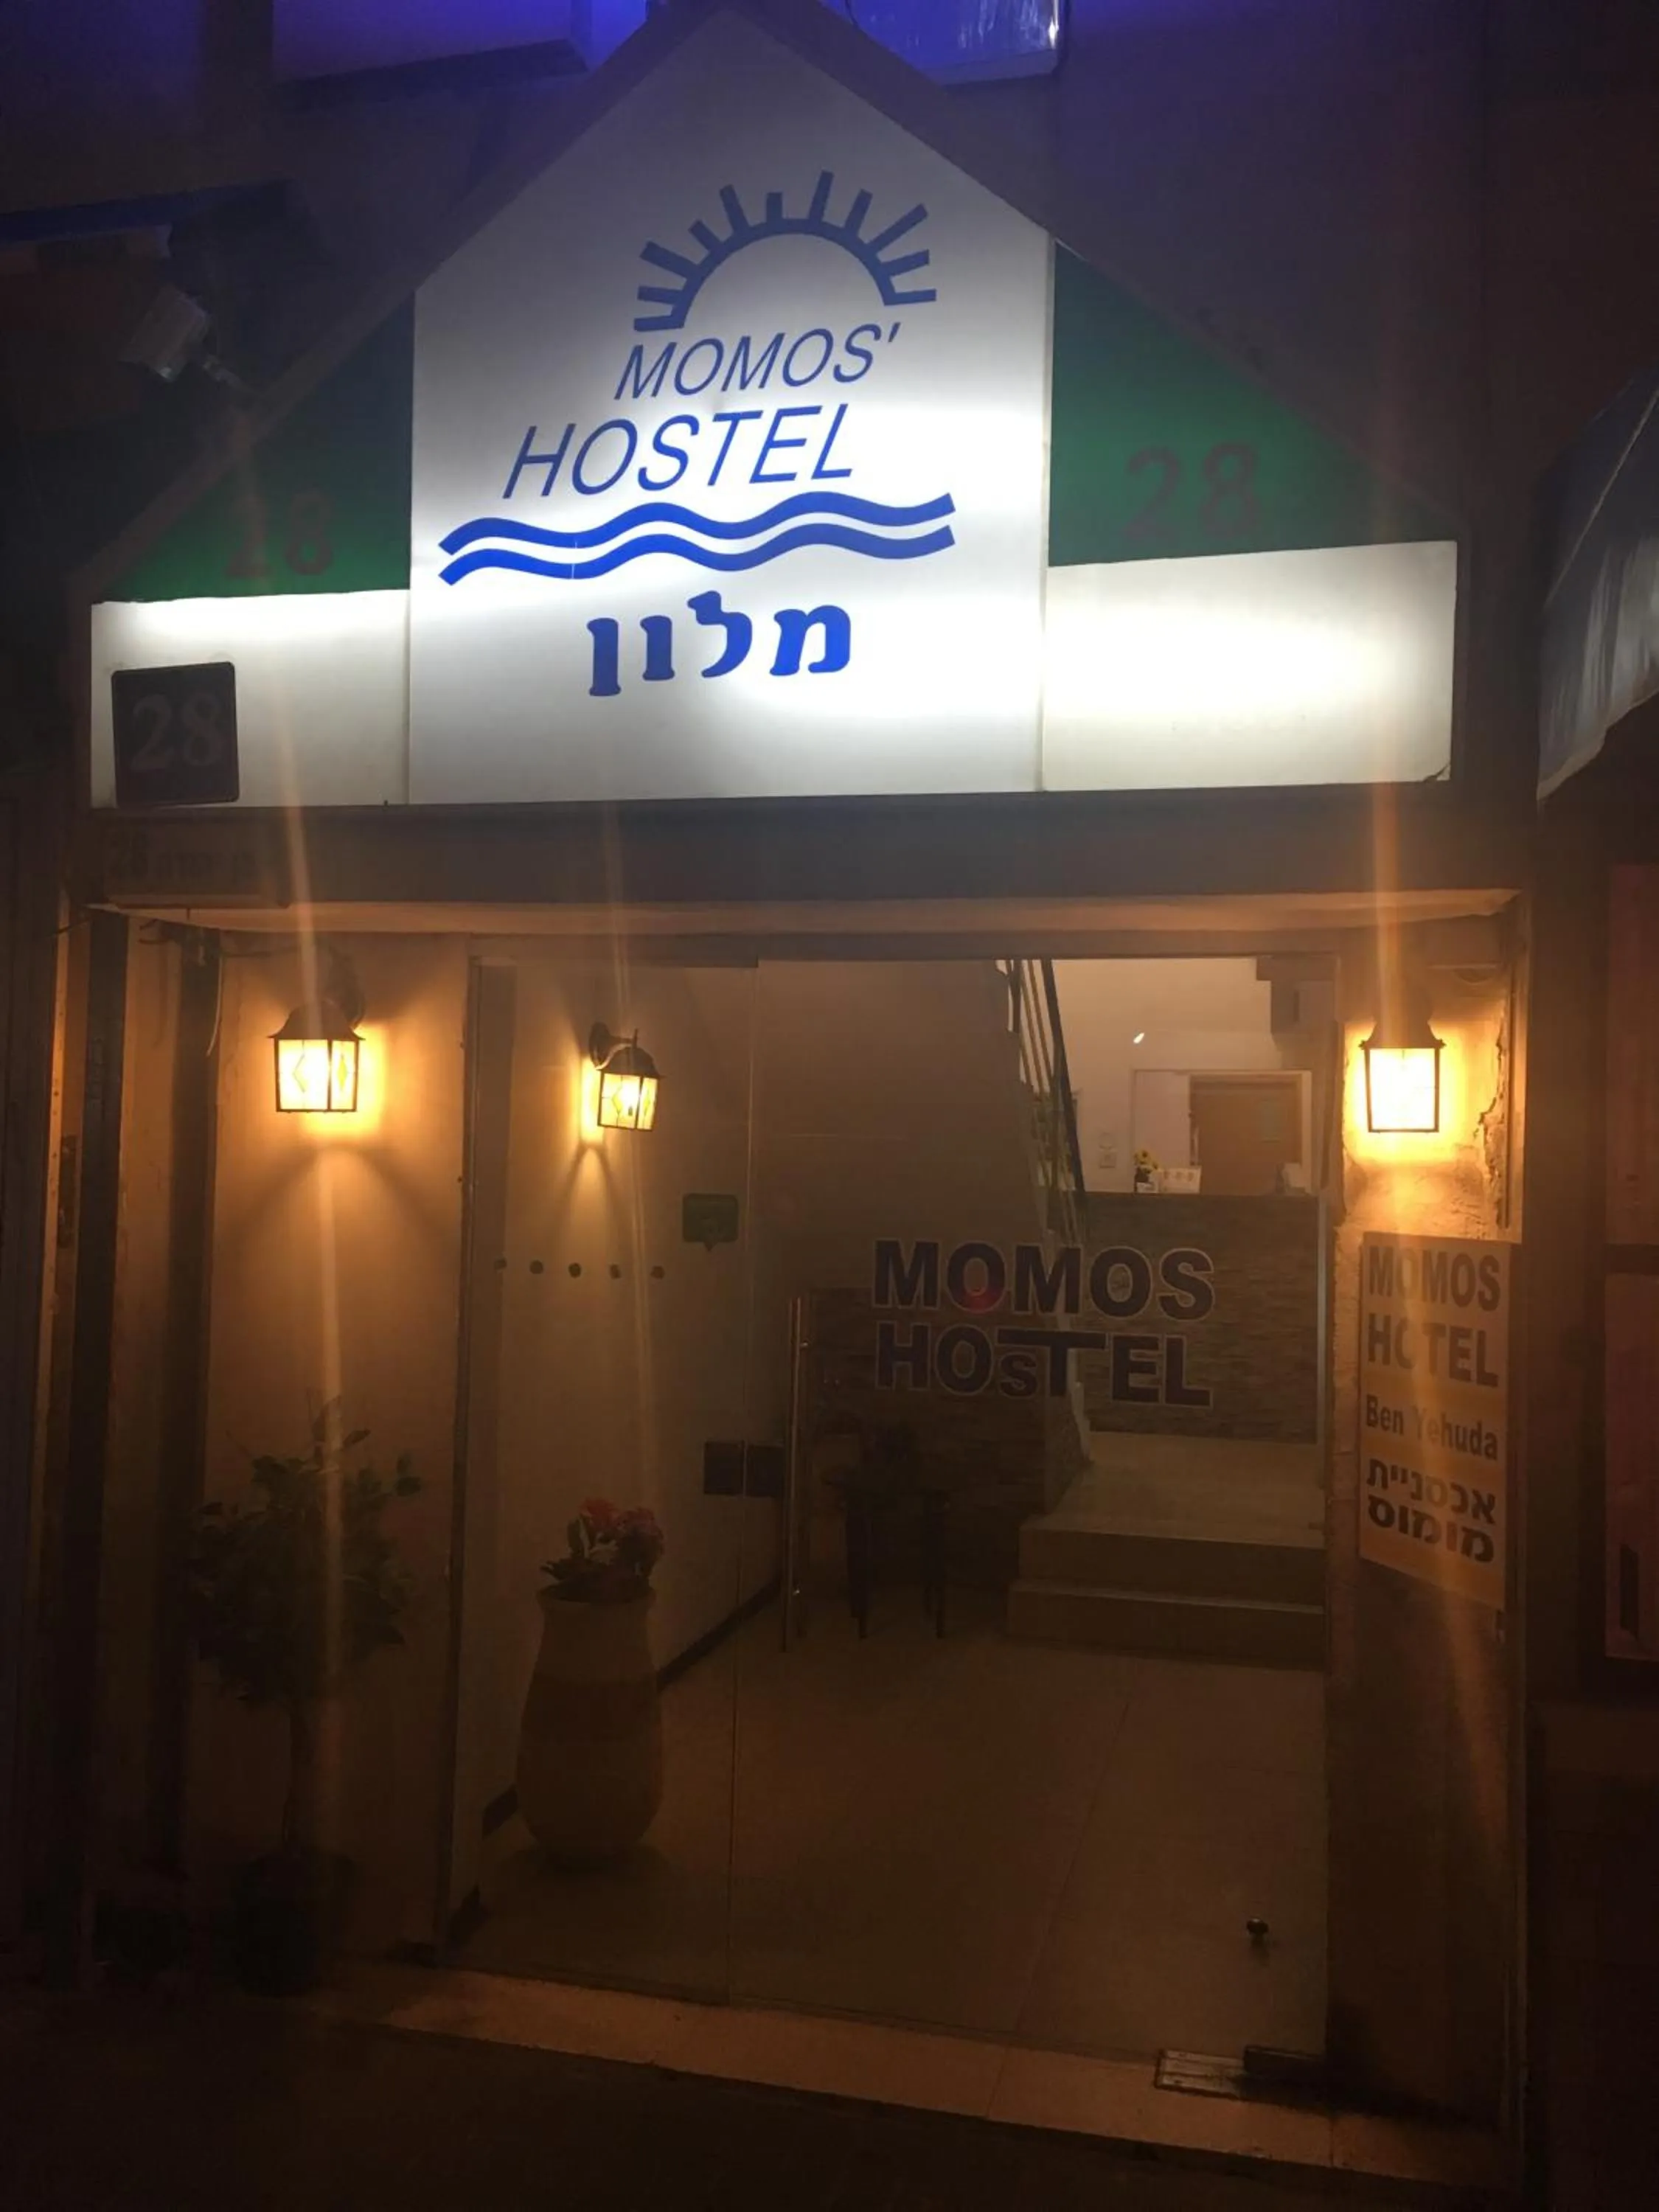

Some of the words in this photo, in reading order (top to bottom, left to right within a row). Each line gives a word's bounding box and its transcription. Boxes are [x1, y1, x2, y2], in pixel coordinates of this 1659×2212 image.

[614, 321, 900, 400] MOMOS'
[503, 403, 854, 499] HOSTEL
[1121, 441, 1261, 540] 28
[587, 590, 852, 697] מלון
[130, 692, 223, 771] 28
[873, 1239, 1215, 1321] MOMOS
[1368, 1245, 1501, 1312] MOMOS
[1366, 1394, 1404, 1435] Ben
[1412, 1404, 1498, 1461] Yehuda
[1366, 1458, 1496, 1524] אכסניית
[1368, 1494, 1495, 1563] מומוס
